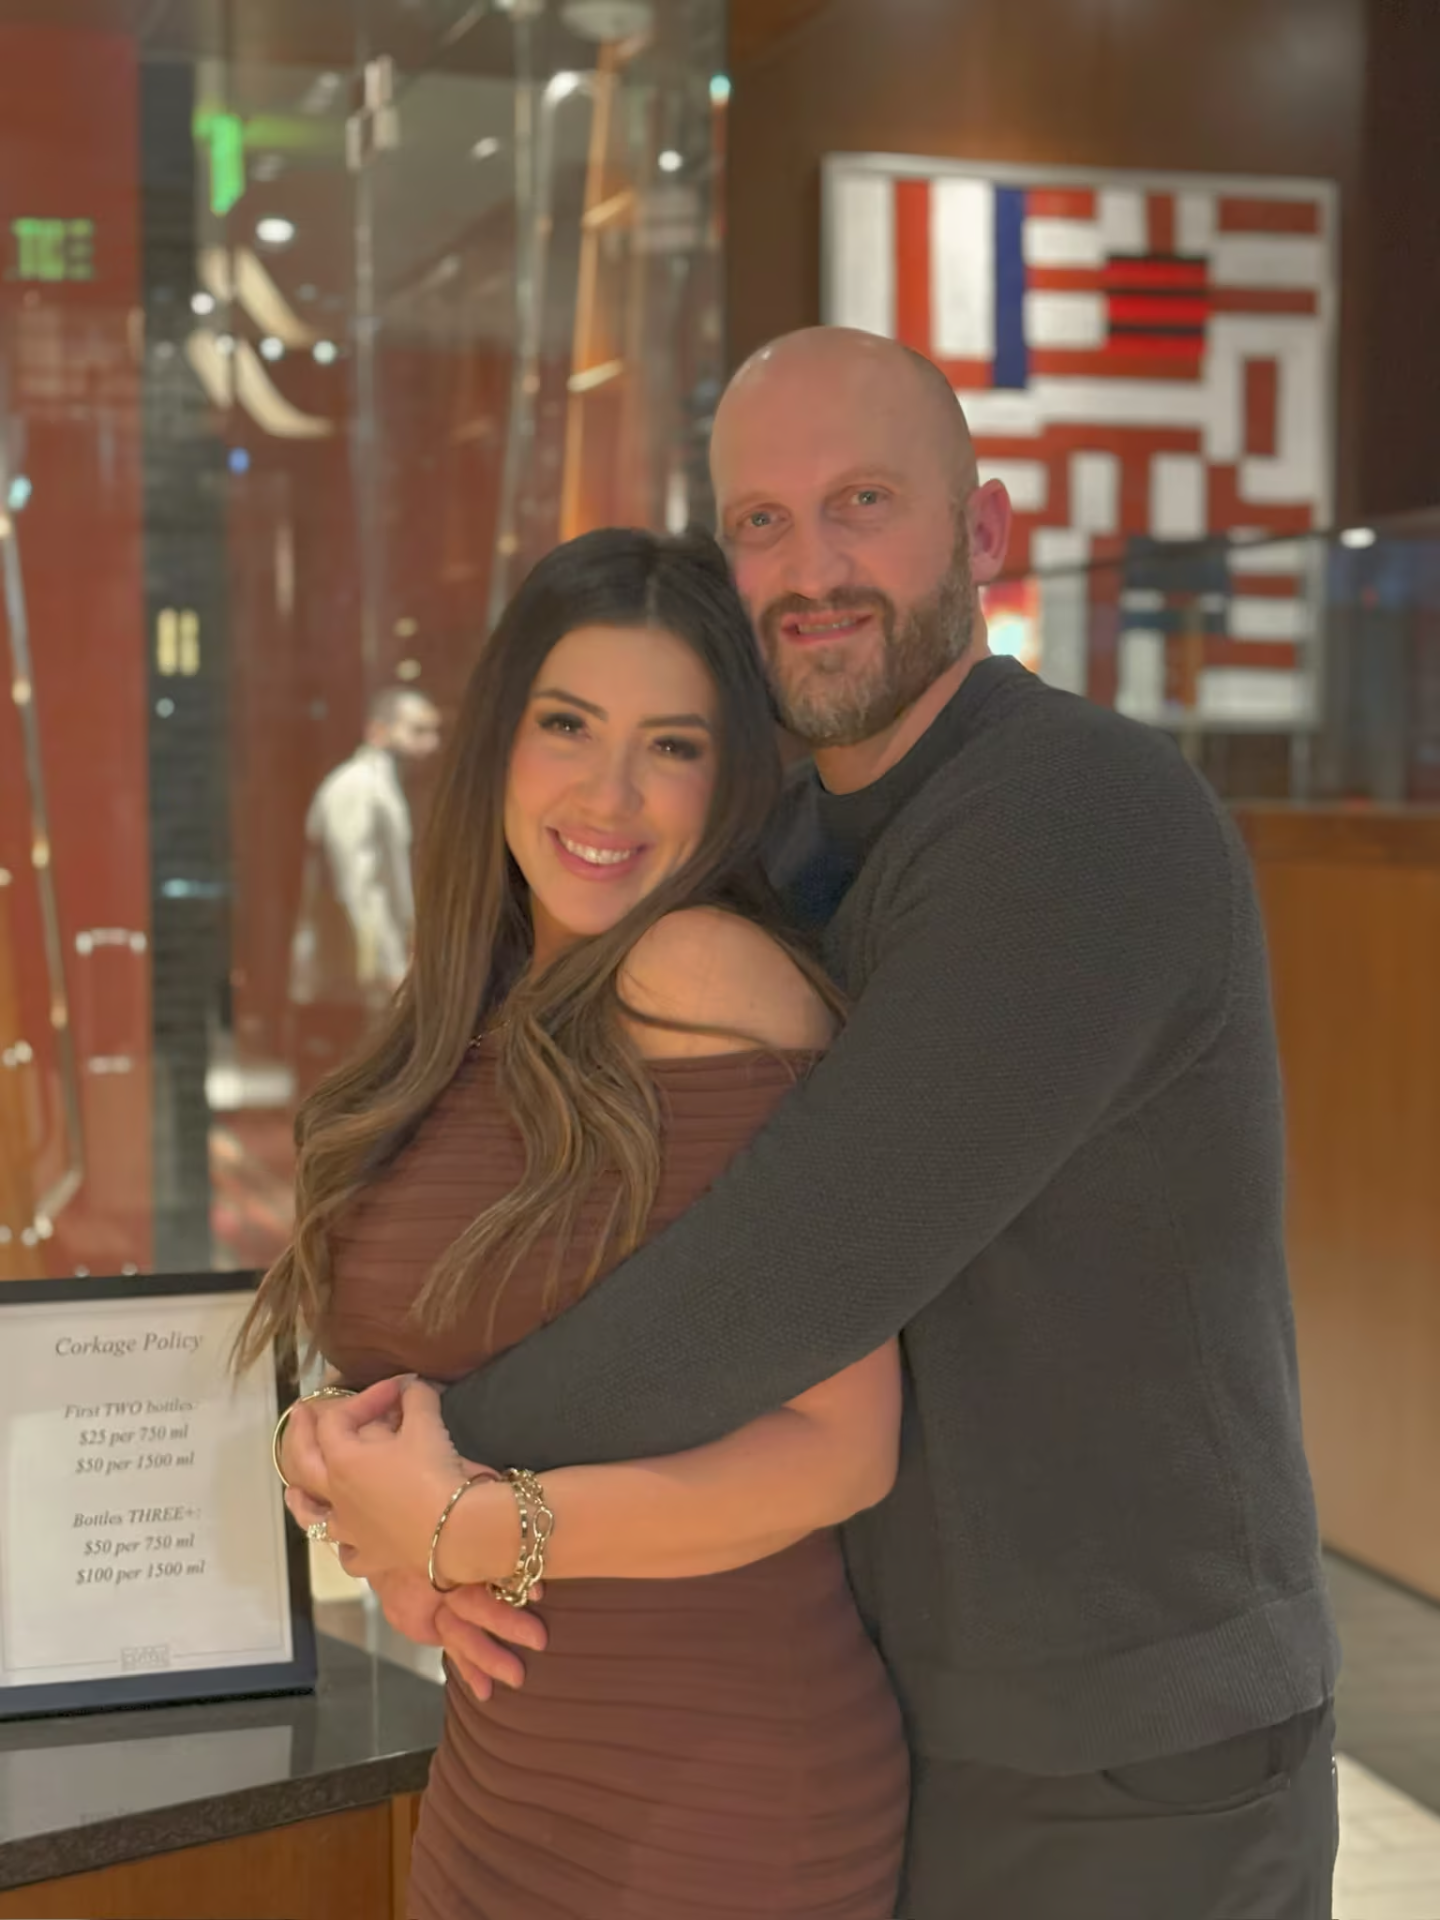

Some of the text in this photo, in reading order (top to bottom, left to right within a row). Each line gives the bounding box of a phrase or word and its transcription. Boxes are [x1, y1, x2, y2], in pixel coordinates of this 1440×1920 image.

[55, 1330, 204, 1357] Corkage Policy
[64, 1404, 101, 1419] First
[104, 1400, 143, 1417] TWO
[78, 1423, 189, 1447] $25 per 750 ml
[75, 1451, 195, 1476] $50 per 1500 ml
[72, 1510, 123, 1528] Bottles
[84, 1533, 195, 1557] $50 per 750 ml
[76, 1560, 206, 1585] $100 per 1500 ml
